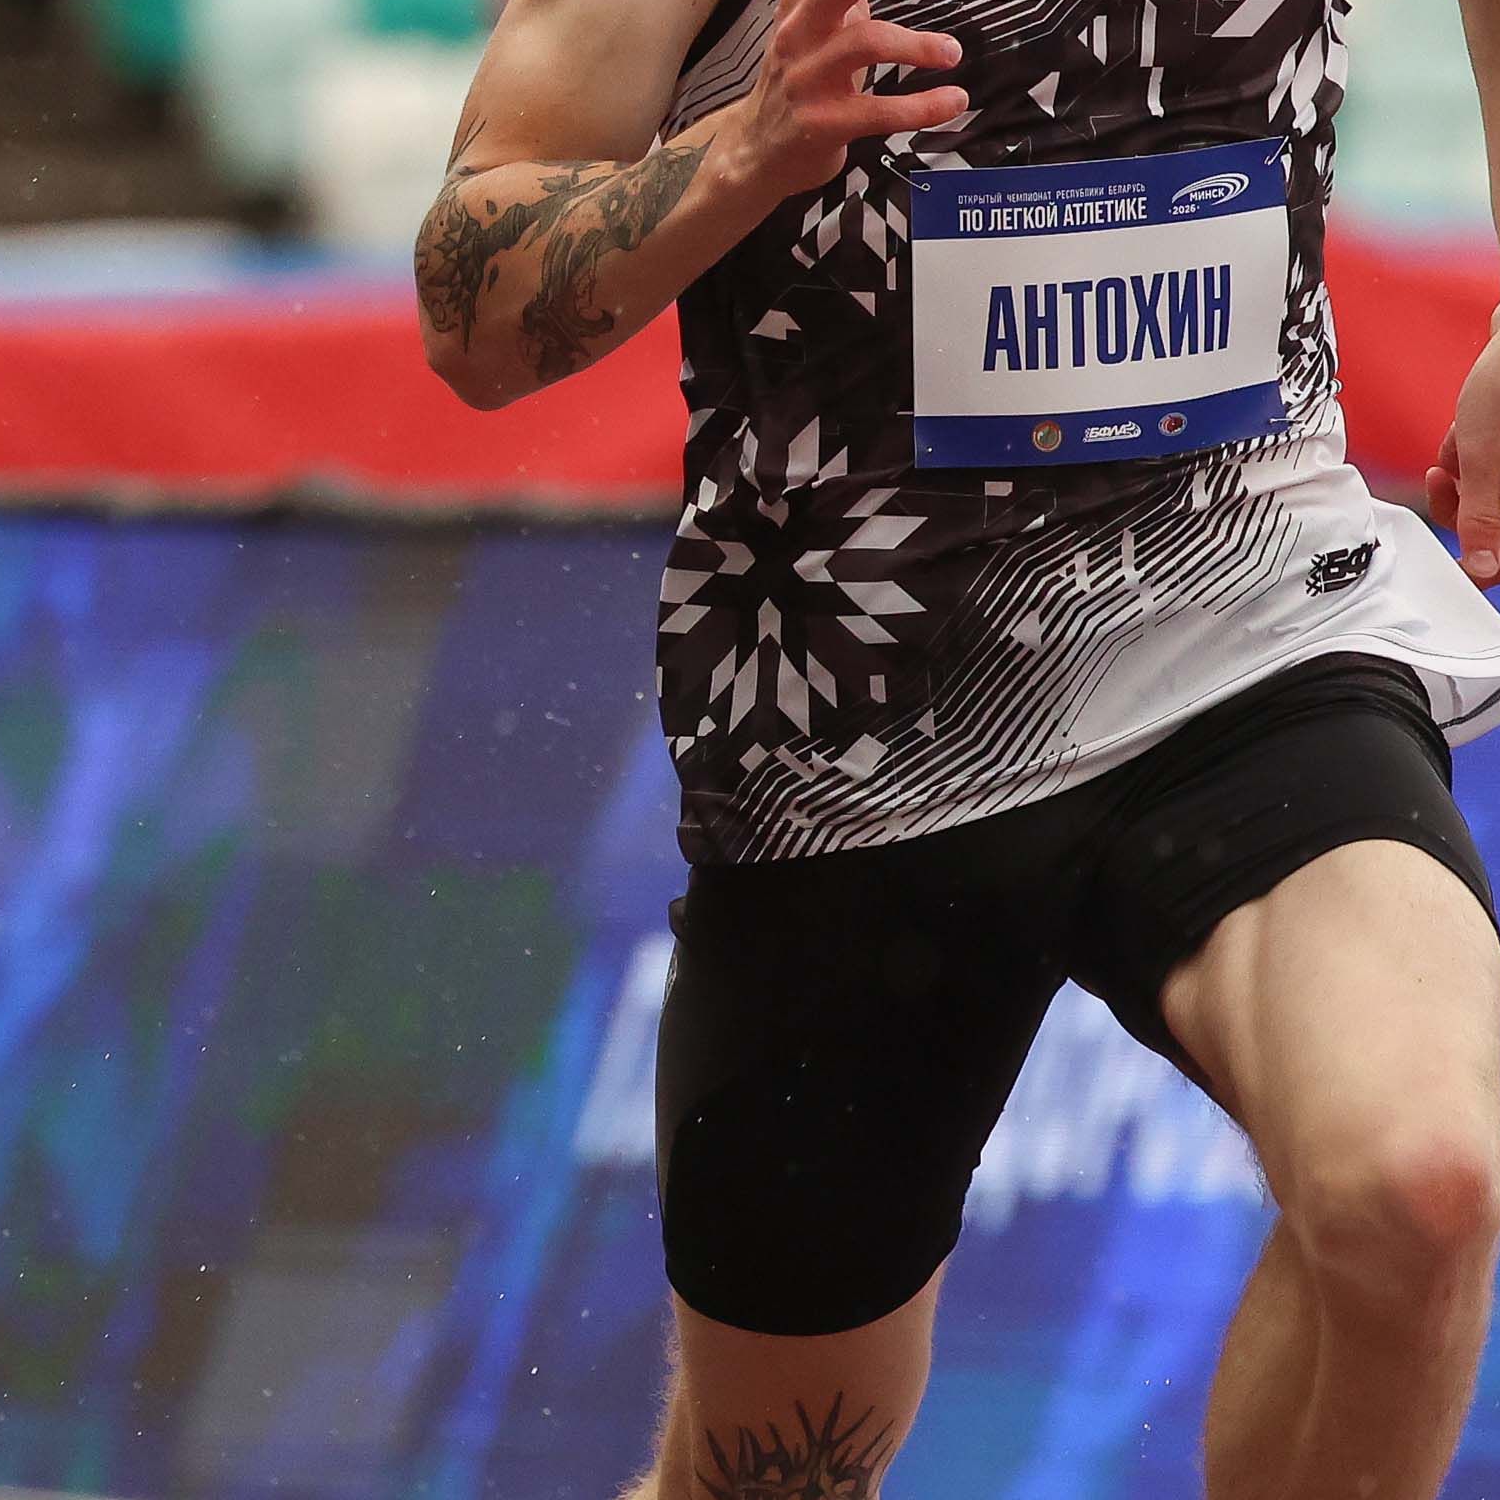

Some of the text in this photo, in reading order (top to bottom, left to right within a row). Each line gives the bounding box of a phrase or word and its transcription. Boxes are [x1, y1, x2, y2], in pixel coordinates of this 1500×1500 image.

[958, 182, 1146, 205] ОТКРЫТЫЙ ЧЕМПИОНАТ РЕСПУБЛИКИ БЕЛАРУСЬ
[1189, 187, 1225, 202] МИНСК
[958, 196, 1148, 232] ПО ЛЕГКОЙ АТЛЕТИКЕ
[982, 264, 1231, 372] АНТОХИН
